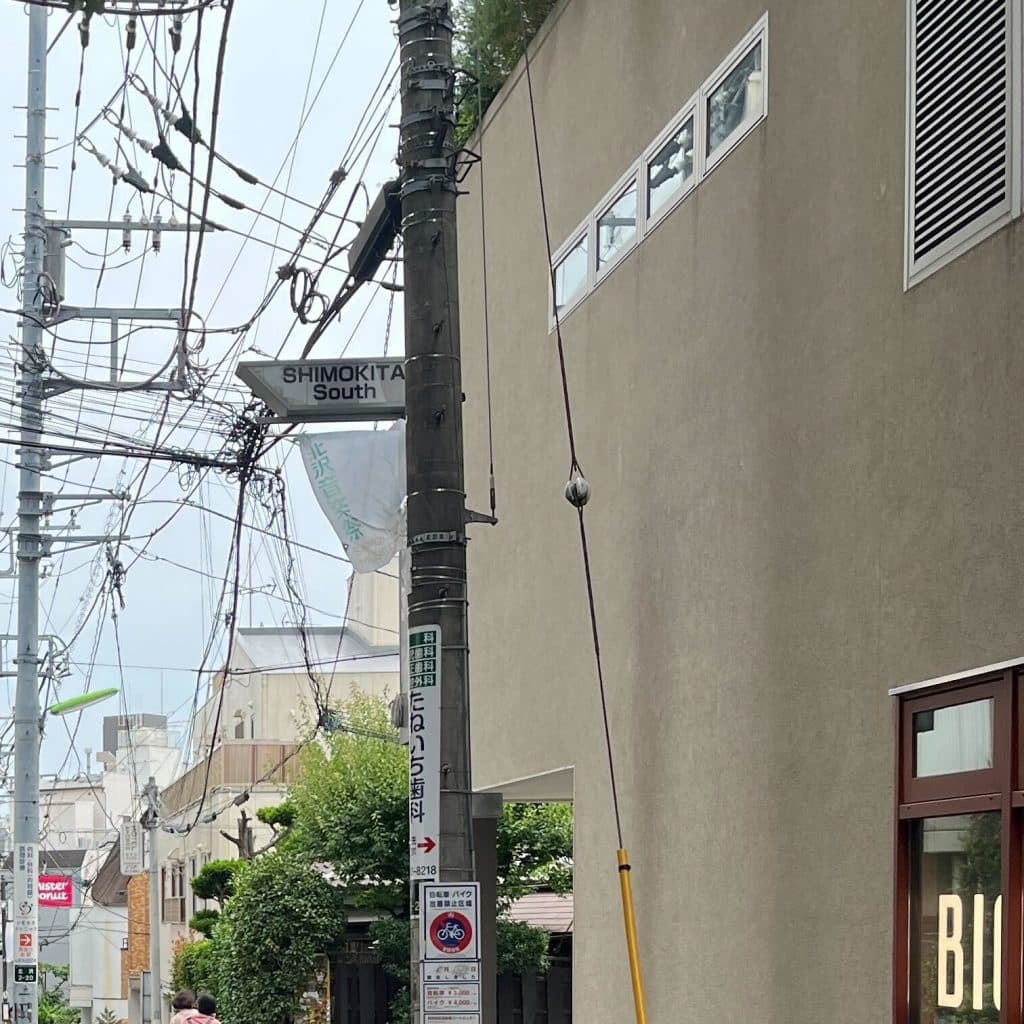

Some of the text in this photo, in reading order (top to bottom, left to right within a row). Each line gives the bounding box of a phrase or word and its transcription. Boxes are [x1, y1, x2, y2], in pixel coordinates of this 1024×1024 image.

[283, 364, 405, 383] SHIMOKITA
[313, 383, 376, 400] South
[39, 881, 69, 891] ister
[39, 891, 69, 901] onut
[452, 890, 472, 898] バイク
